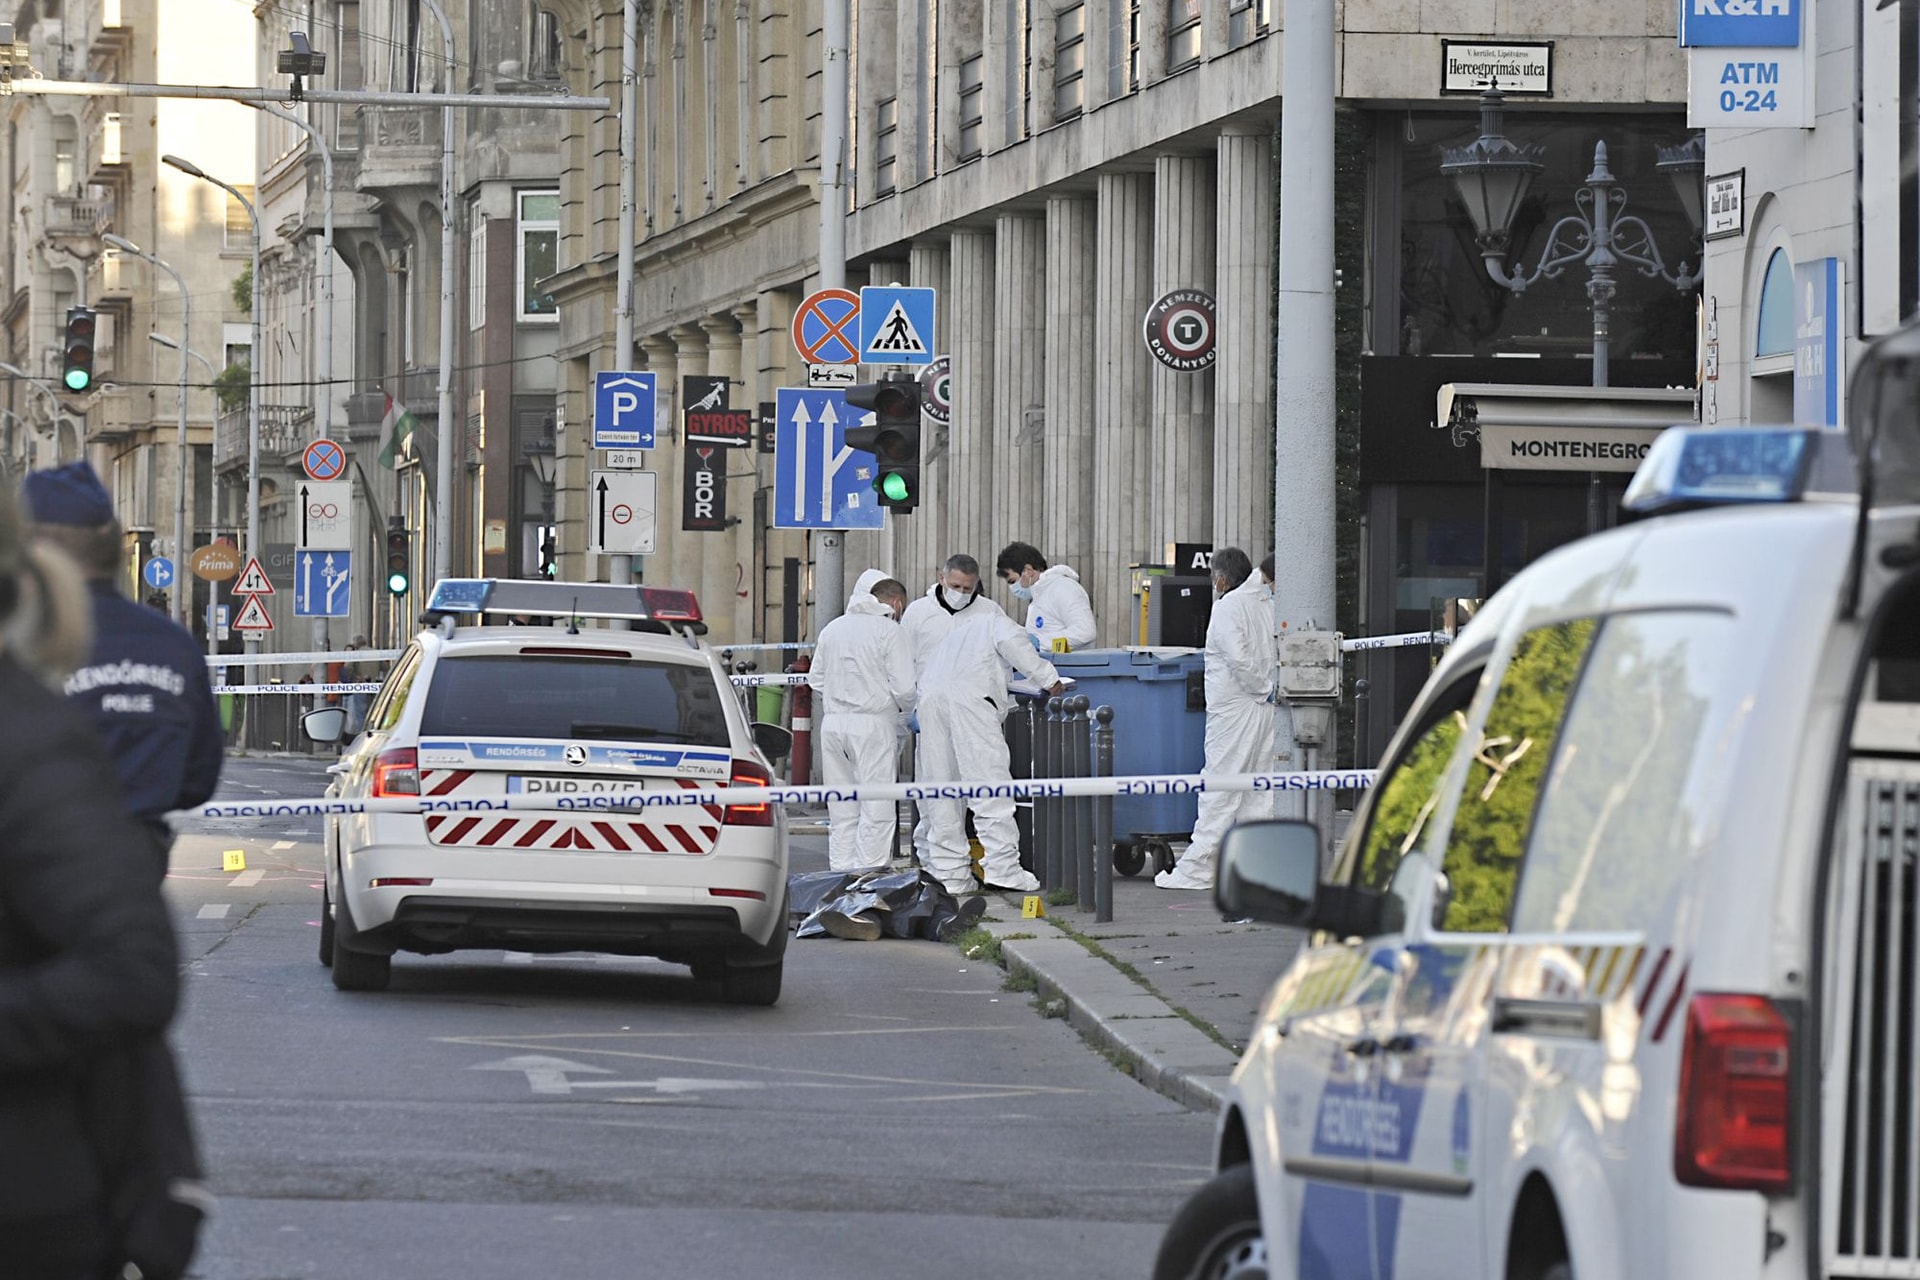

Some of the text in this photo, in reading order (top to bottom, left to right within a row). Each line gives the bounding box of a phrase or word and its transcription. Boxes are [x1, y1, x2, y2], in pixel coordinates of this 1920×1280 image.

[1694, 0, 1790, 16] K&H
[1449, 58, 1545, 79] Hercegprímás utca
[1720, 63, 1778, 84] ATM
[1720, 90, 1777, 112] 0-24
[1159, 293, 1216, 312] NEMZETI
[1180, 324, 1196, 338] T
[1151, 339, 1216, 368] DOHÁNYBO
[613, 392, 637, 426] P
[687, 412, 749, 435] GYROS
[613, 455, 624, 463] 20
[695, 471, 714, 519] BOR
[198, 560, 234, 572] Prima
[1355, 639, 1386, 650] POLICE
[257, 684, 299, 692] POLICE
[732, 677, 764, 686] OLICE
[486, 747, 547, 757] RENDŐRSÉG
[677, 765, 724, 775] OCTAVIA
[1118, 778, 1205, 795] POLICE
[1253, 774, 1374, 791] NDORSEG
[770, 790, 857, 802] POLICE
[420, 800, 508, 811] POLICE
